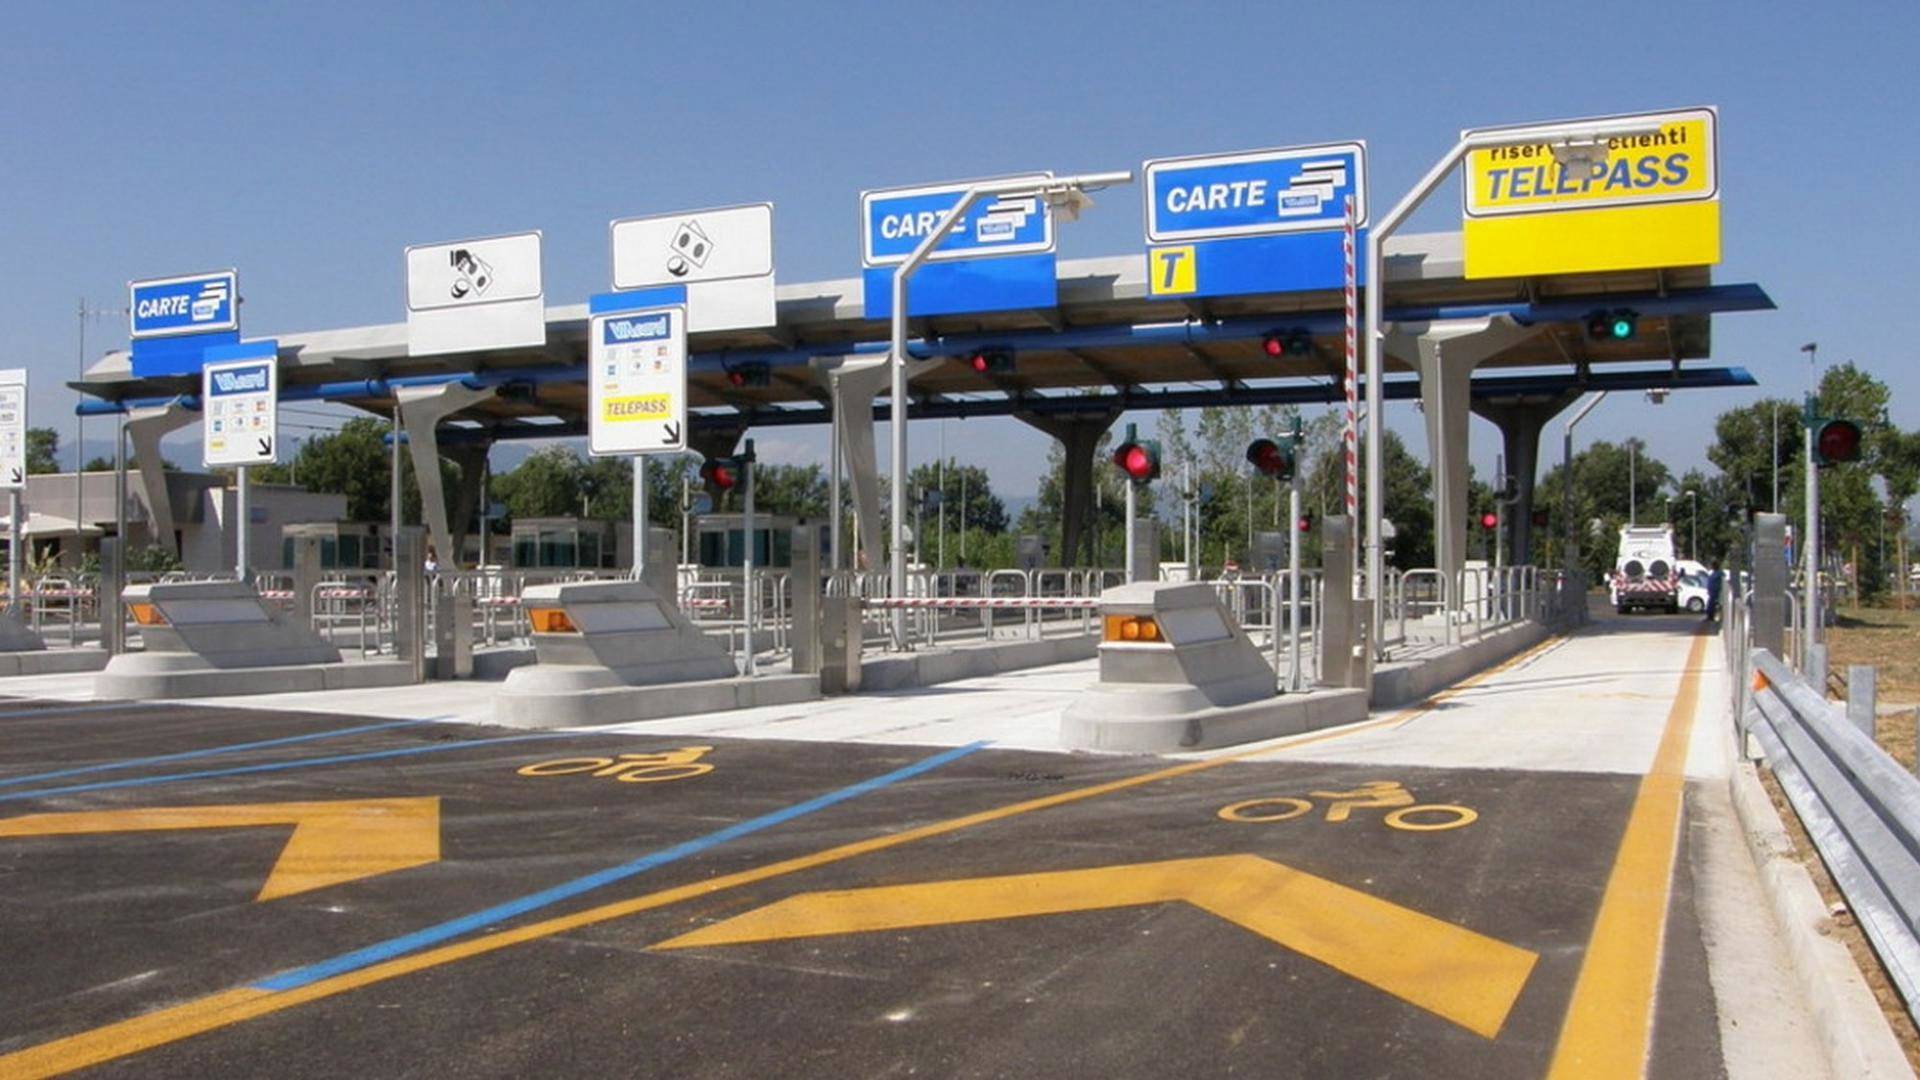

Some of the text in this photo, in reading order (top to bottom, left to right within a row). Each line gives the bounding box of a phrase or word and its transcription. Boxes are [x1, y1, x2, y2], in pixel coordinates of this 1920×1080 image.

[1487, 153, 1690, 200] TELEPASS
[1166, 179, 1267, 213] CARTE
[1160, 252, 1184, 289] T
[138, 294, 190, 319] CARTE
[607, 399, 666, 416] TELEPASS
